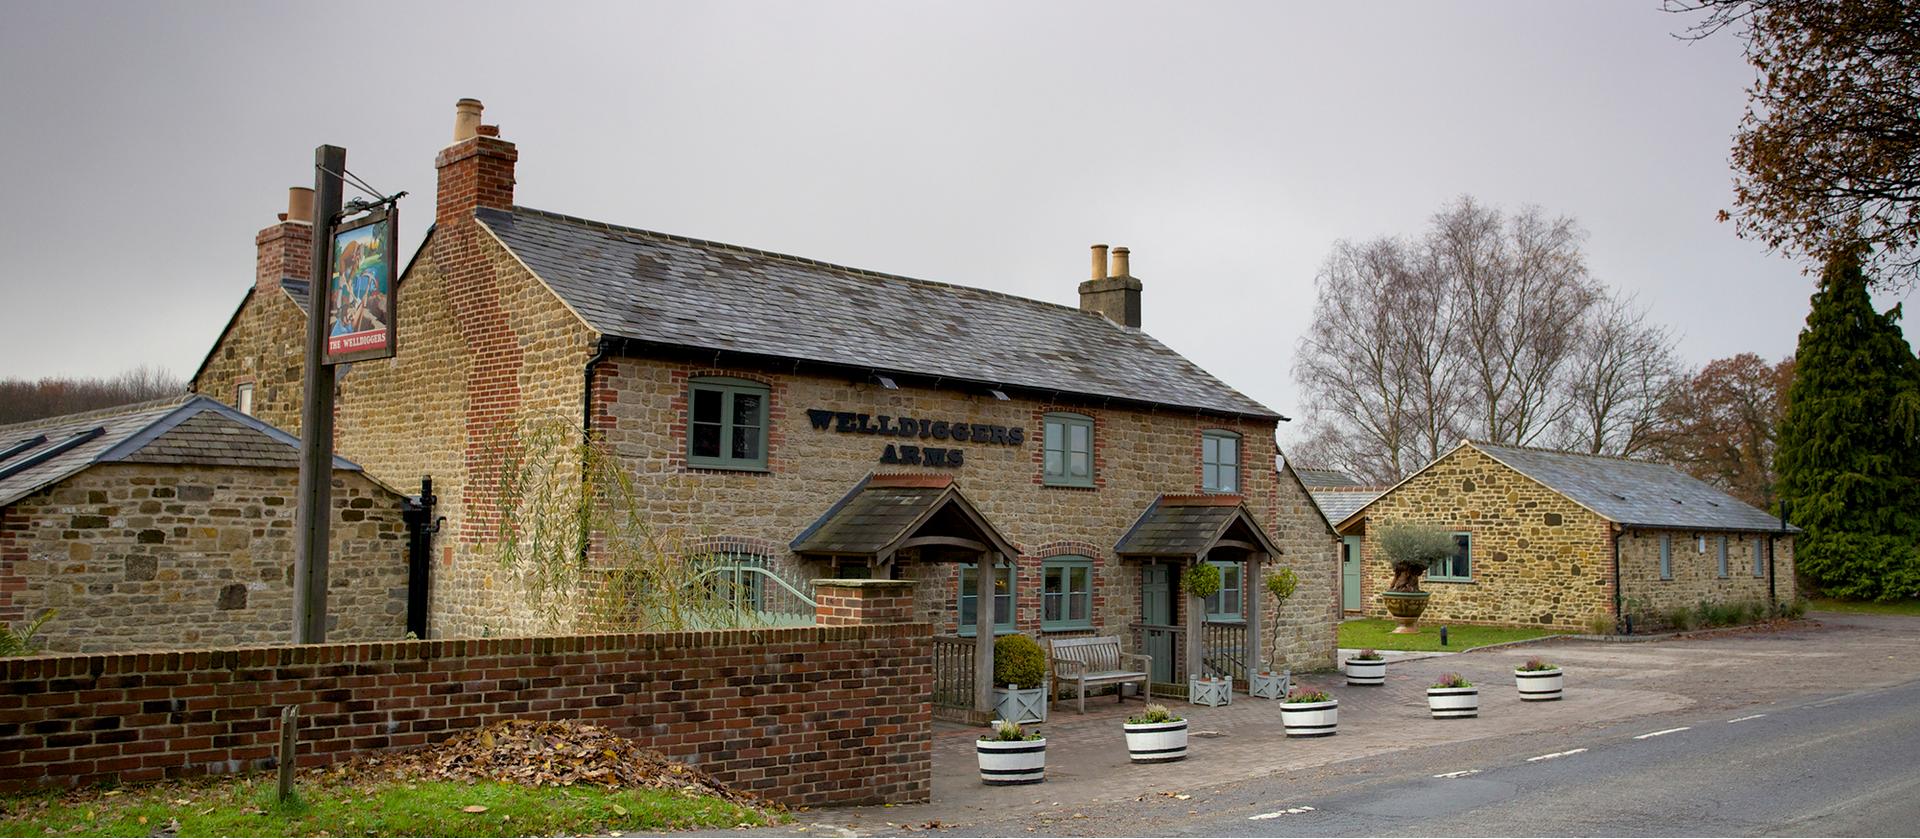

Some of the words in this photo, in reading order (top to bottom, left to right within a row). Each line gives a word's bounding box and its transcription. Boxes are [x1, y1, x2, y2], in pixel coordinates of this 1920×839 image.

[330, 341, 341, 350] THE
[343, 333, 386, 347] WELLDIGGERS
[806, 409, 1025, 446] WELLDIGGERS
[880, 444, 964, 468] ARMS
